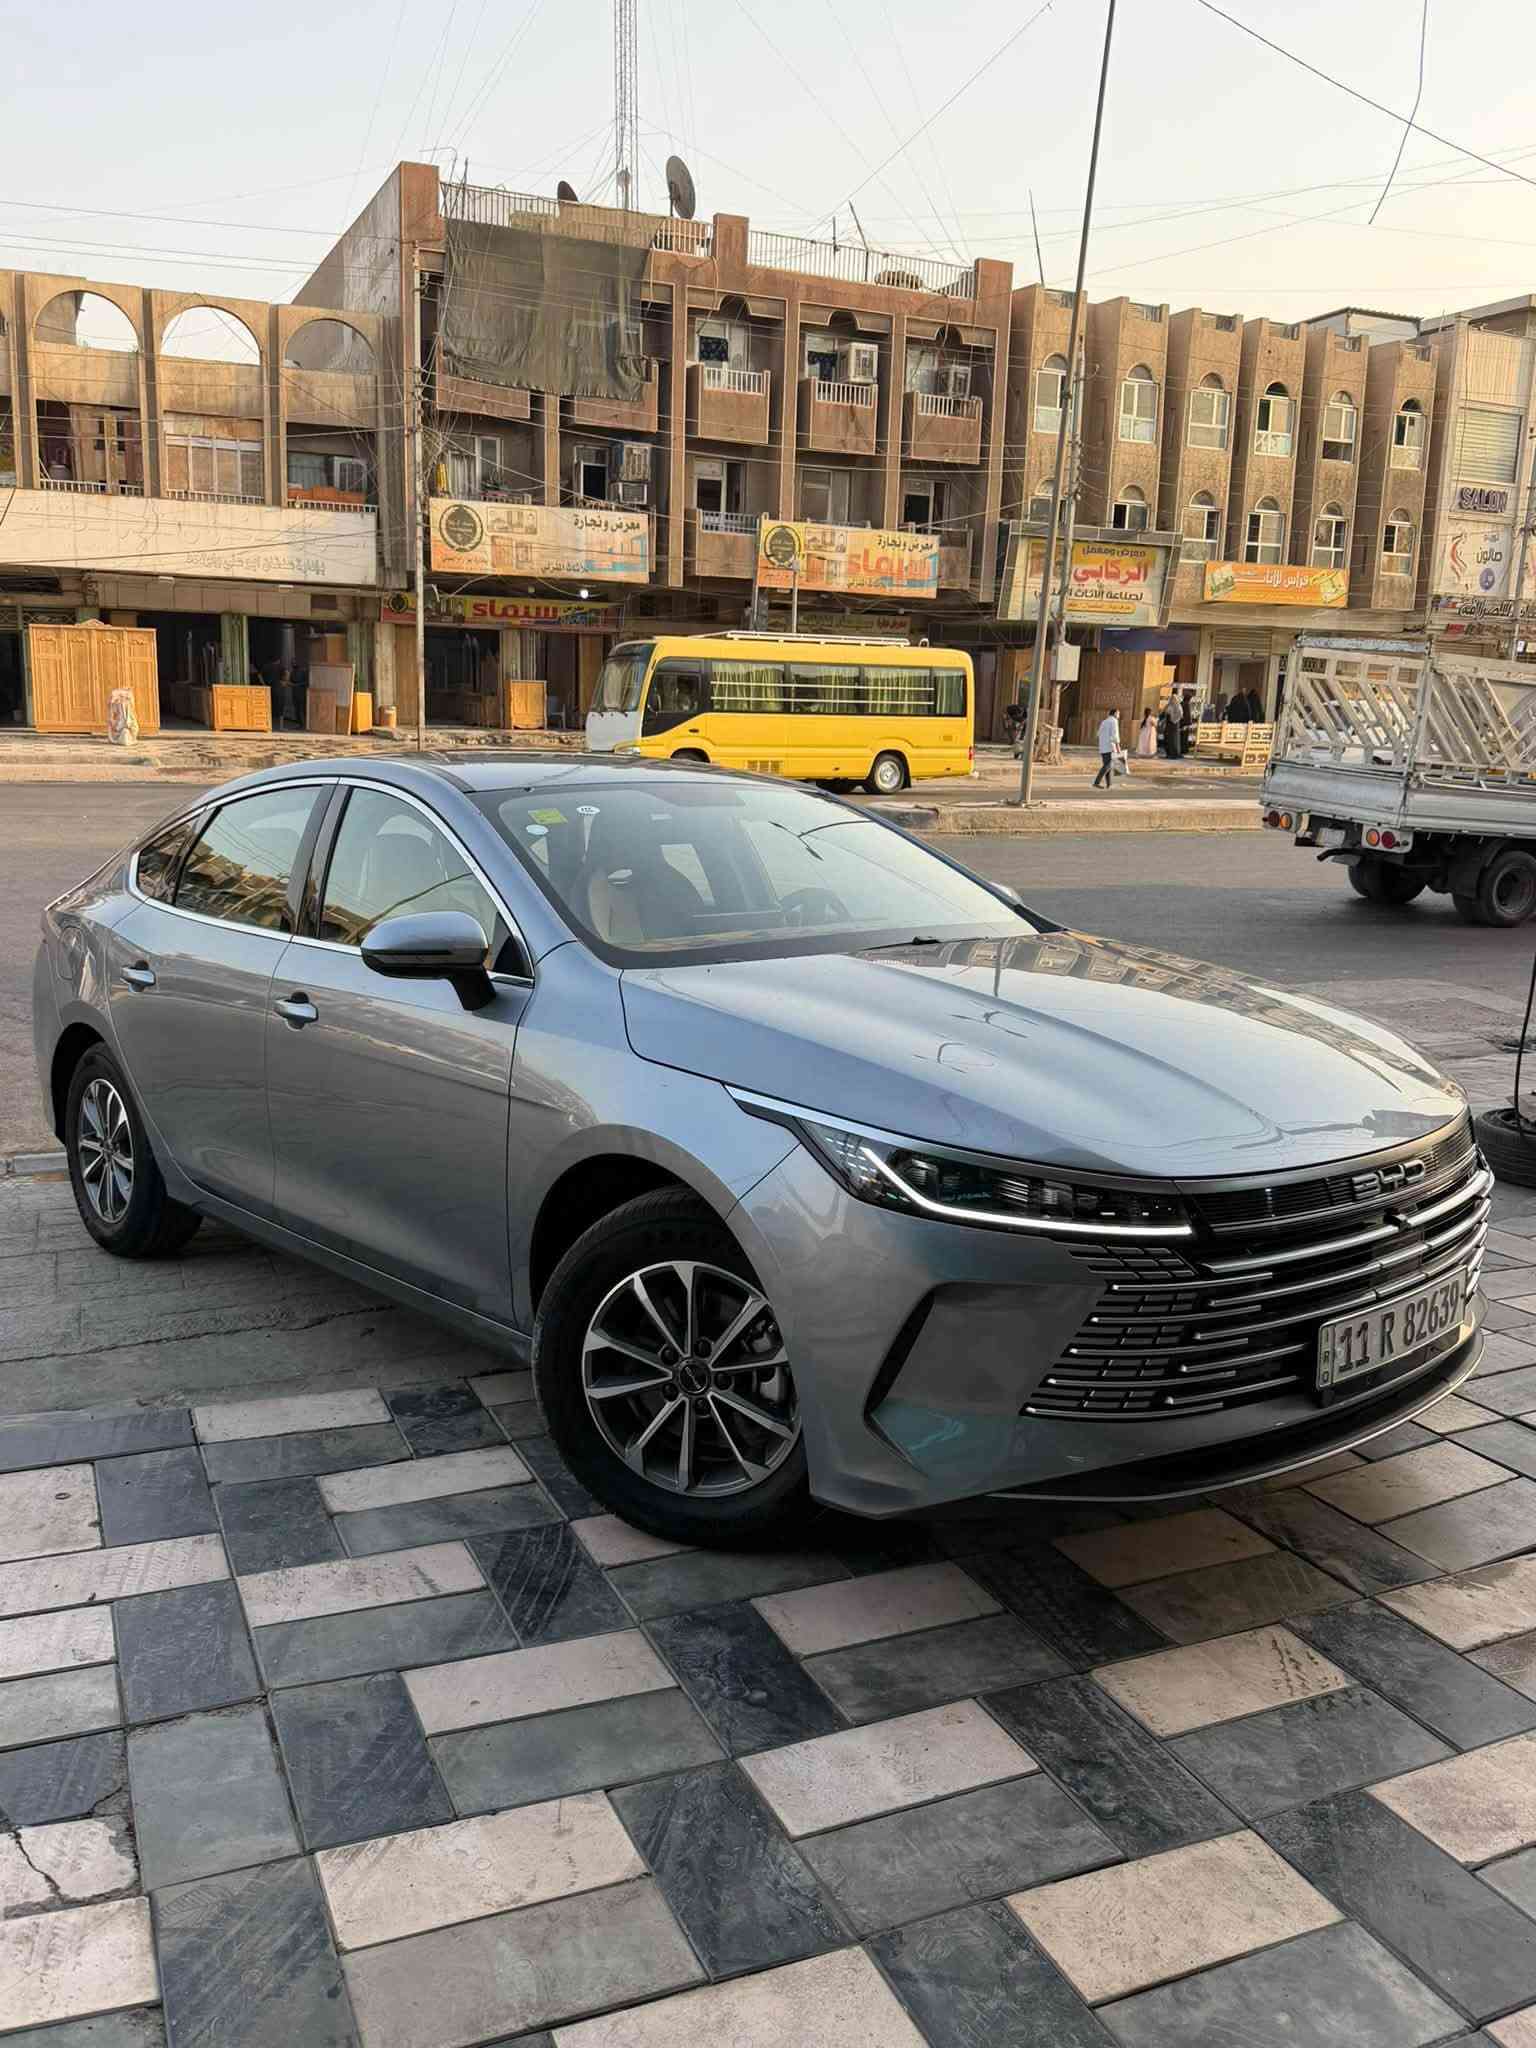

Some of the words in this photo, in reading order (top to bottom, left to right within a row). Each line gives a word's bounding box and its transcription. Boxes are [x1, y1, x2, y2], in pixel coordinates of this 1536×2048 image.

[1459, 487, 1507, 513] SALON
[610, 516, 641, 533] معرض
[1476, 547, 1503, 565] صالون
[1073, 559, 1150, 587] الركابي
[1351, 1159, 1426, 1200] BYD
[1338, 1321, 1371, 1374] 11
[1379, 1310, 1396, 1357] R
[1403, 1279, 1459, 1346] 82639
